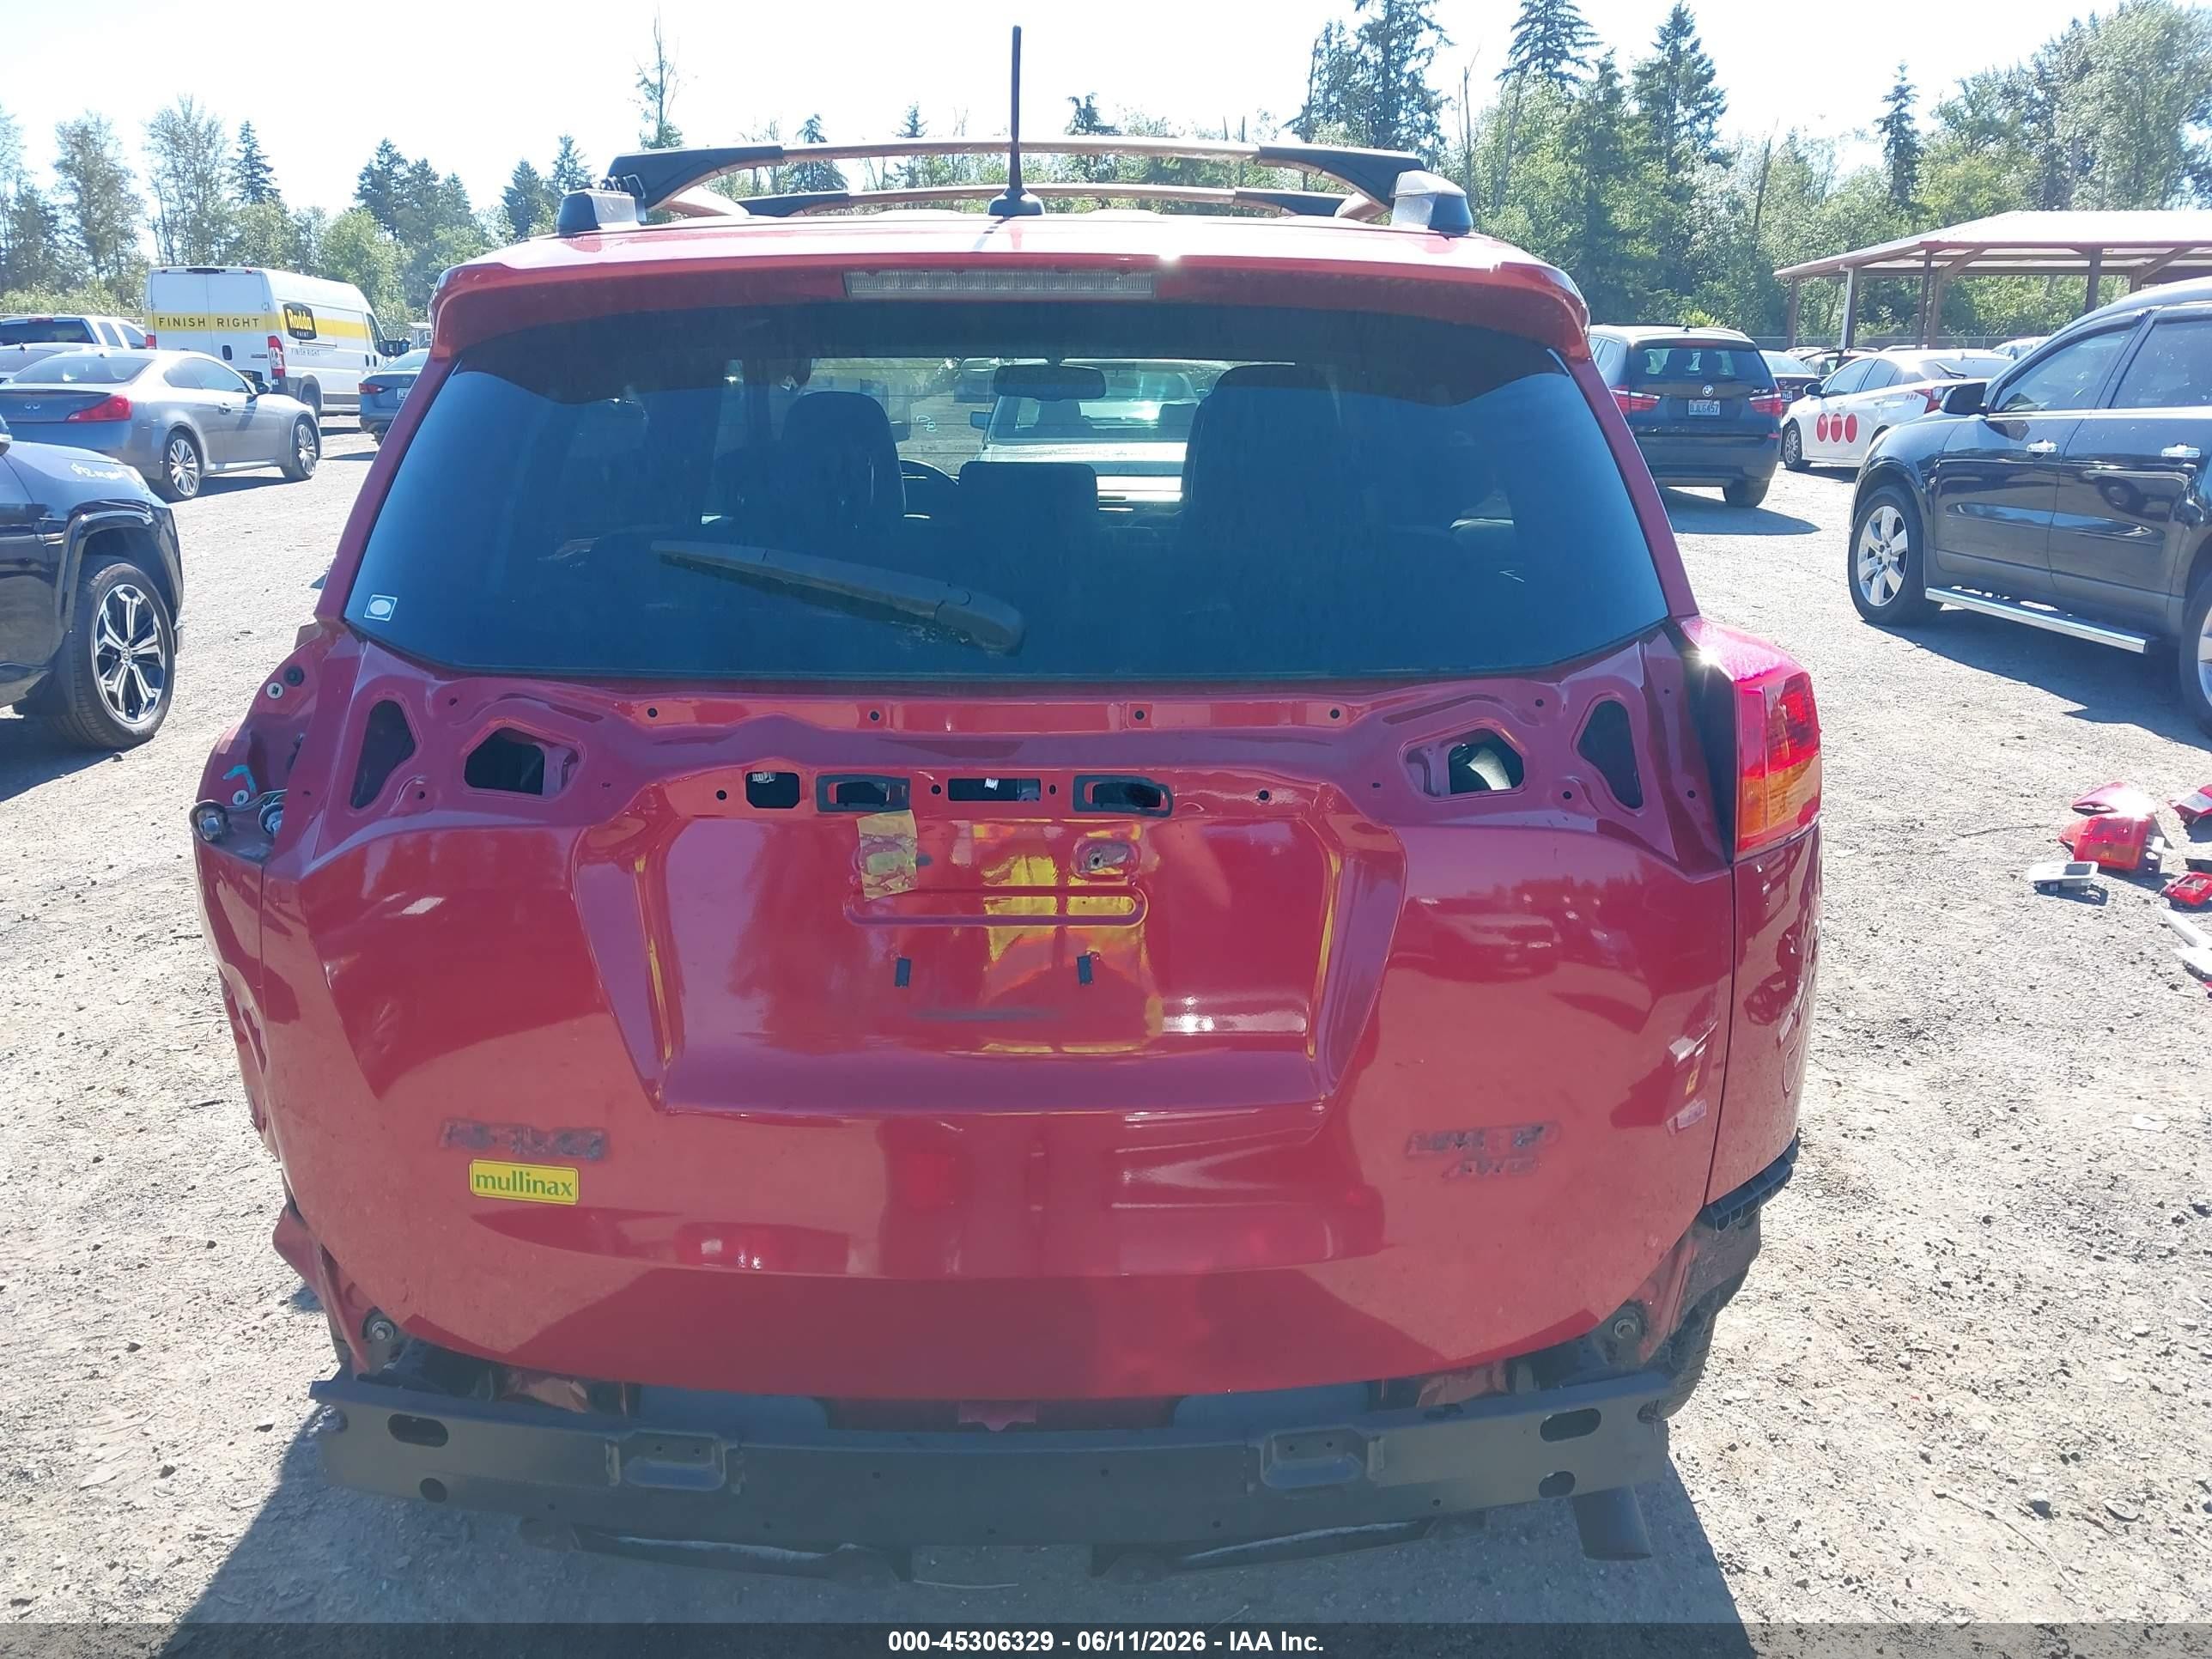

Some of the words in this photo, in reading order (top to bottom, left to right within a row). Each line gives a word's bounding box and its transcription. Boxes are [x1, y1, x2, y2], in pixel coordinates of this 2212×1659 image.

[159, 317, 205, 327] FINISH
[217, 318, 259, 328] RIGHT
[286, 309, 313, 330] Rodda
[475, 1170, 573, 1196] mullinax
